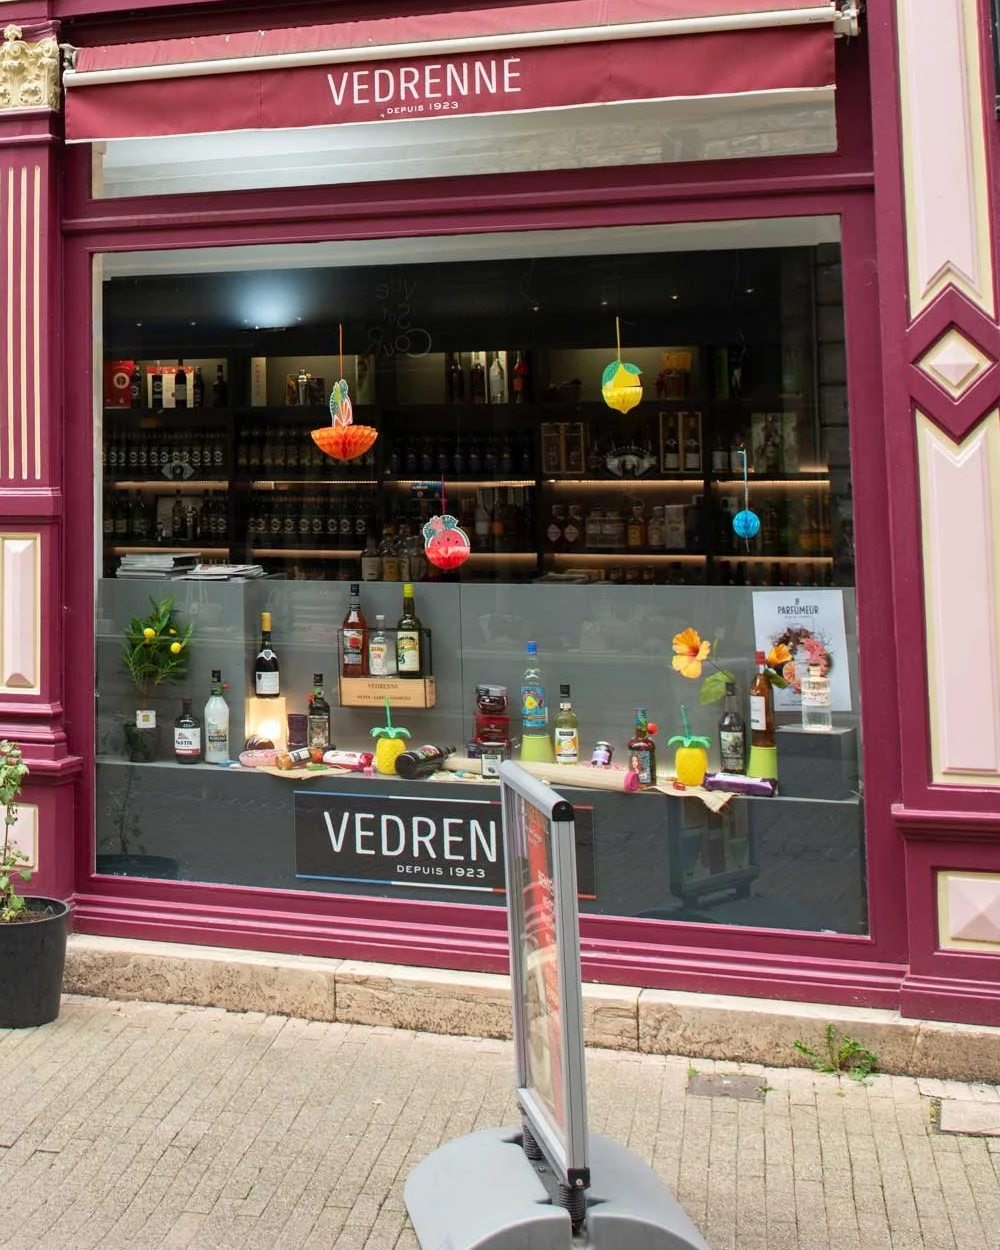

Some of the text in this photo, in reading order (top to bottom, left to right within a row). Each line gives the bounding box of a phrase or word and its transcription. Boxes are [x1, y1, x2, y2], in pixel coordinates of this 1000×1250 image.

[327, 57, 522, 106] VEDRENNE
[386, 101, 459, 115] DEPUIS 1923
[777, 605, 819, 615] PARFUMEUR
[323, 811, 497, 863] VEDREN
[396, 864, 486, 879] DEPUIS 1923
